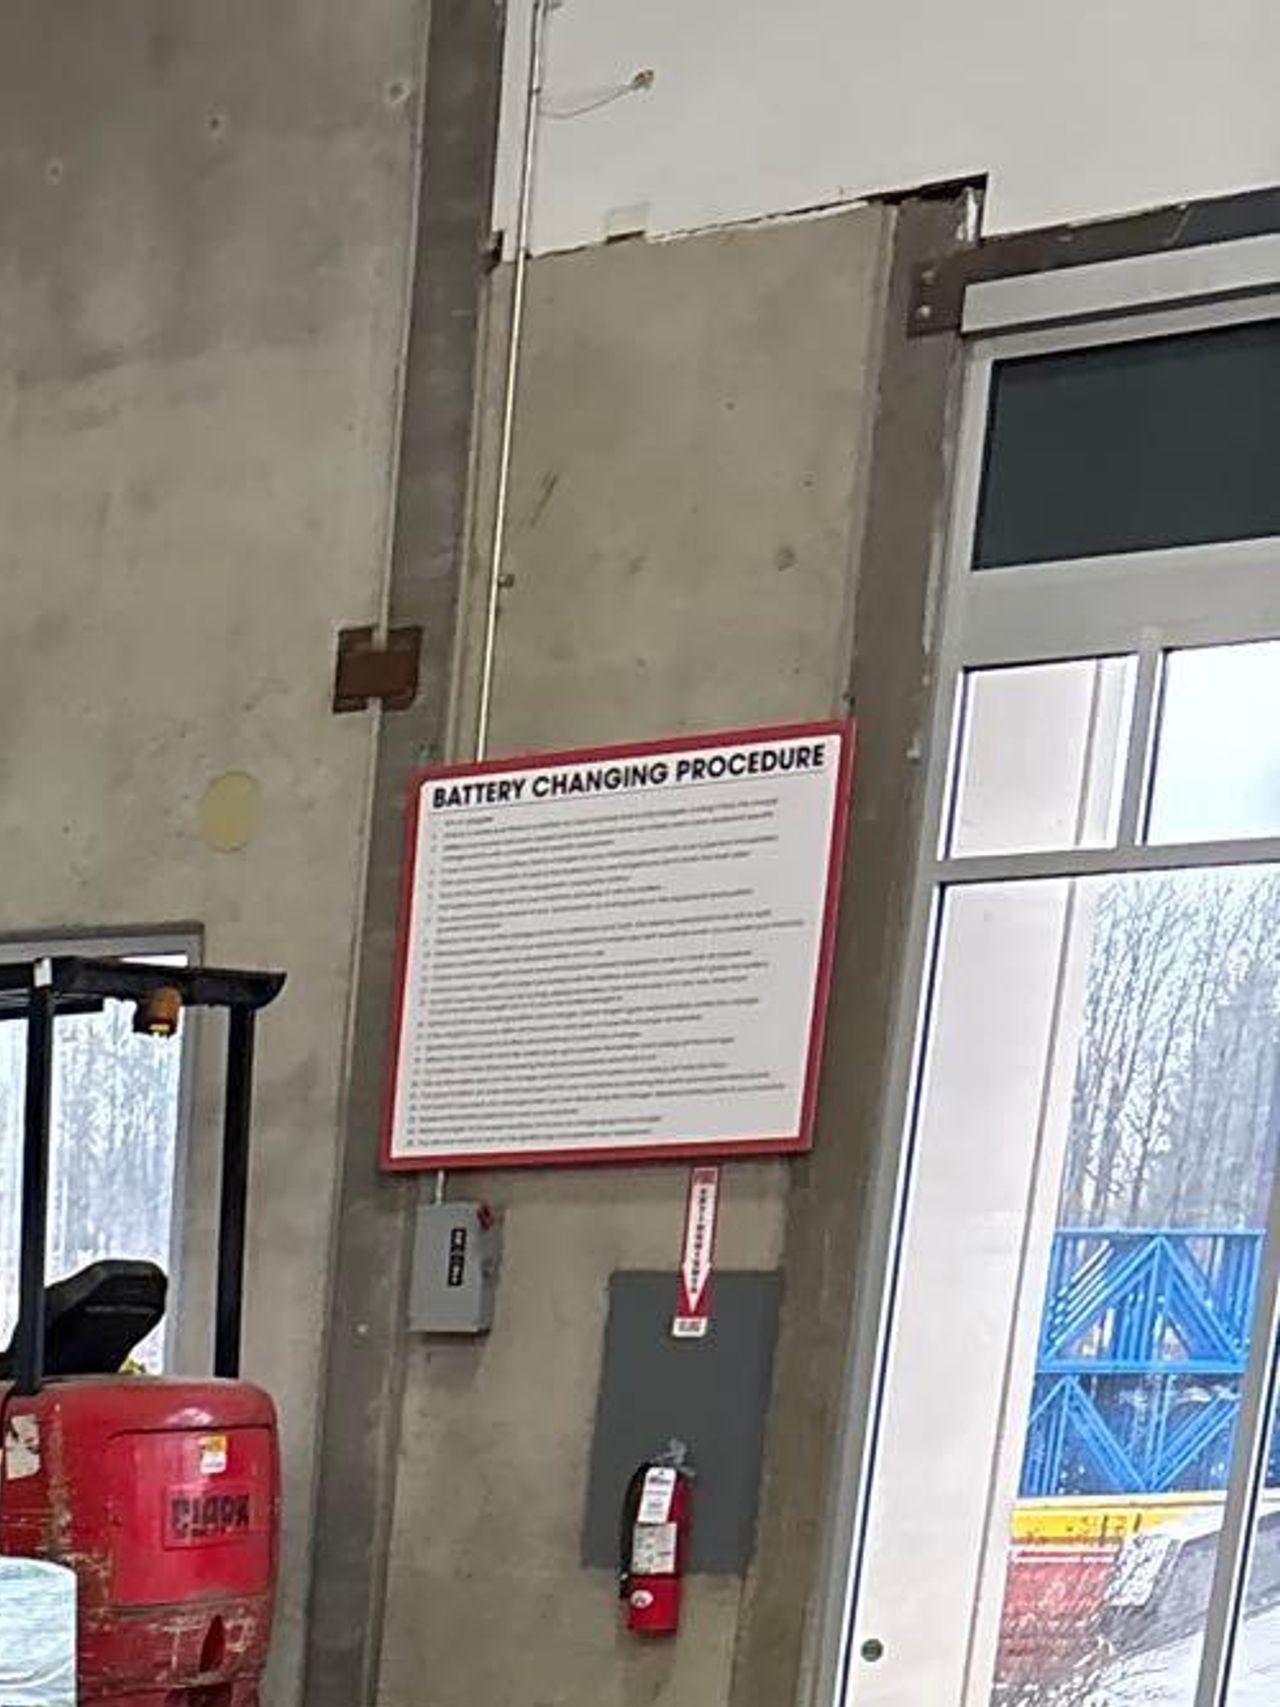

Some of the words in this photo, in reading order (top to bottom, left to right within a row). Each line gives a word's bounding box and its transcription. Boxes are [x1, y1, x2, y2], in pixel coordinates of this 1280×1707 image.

[432, 778, 523, 809] BATTERY
[532, 762, 668, 798] CHANGING
[675, 743, 827, 783] PROCEDURE
